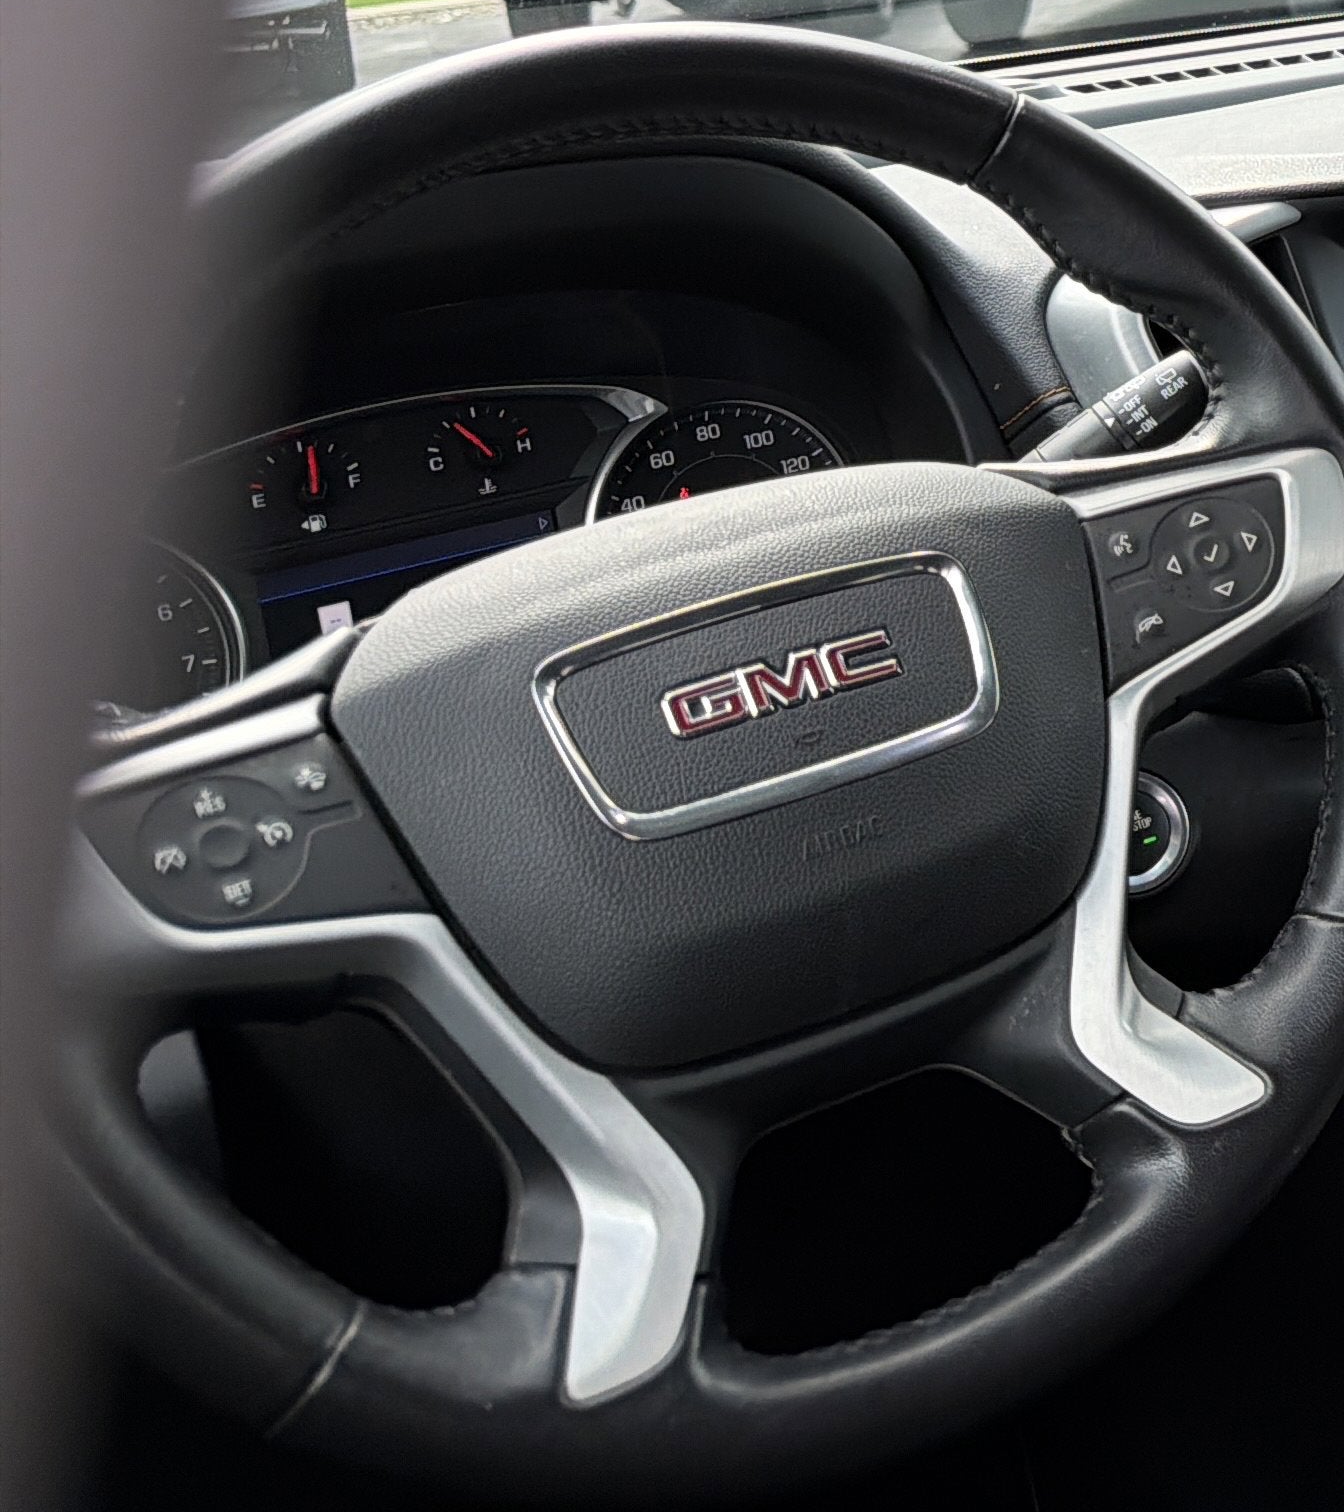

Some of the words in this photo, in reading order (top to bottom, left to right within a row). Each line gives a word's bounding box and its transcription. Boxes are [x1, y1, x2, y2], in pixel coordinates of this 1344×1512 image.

[1160, 376, 1189, 400] REAR
[1123, 394, 1142, 412] OFF
[1131, 404, 1150, 421] INT
[696, 423, 721, 442] 80
[1140, 416, 1158, 434] ON
[517, 437, 532, 453] H
[743, 429, 775, 450] 100
[429, 455, 445, 472] C
[650, 450, 675, 470] 60
[780, 454, 811, 474] 120
[348, 473, 361, 489] F
[252, 493, 266, 509] E
[621, 495, 646, 513] 40
[155, 603, 173, 623] 6
[181, 653, 196, 672] 7
[661, 630, 903, 737] GMC
